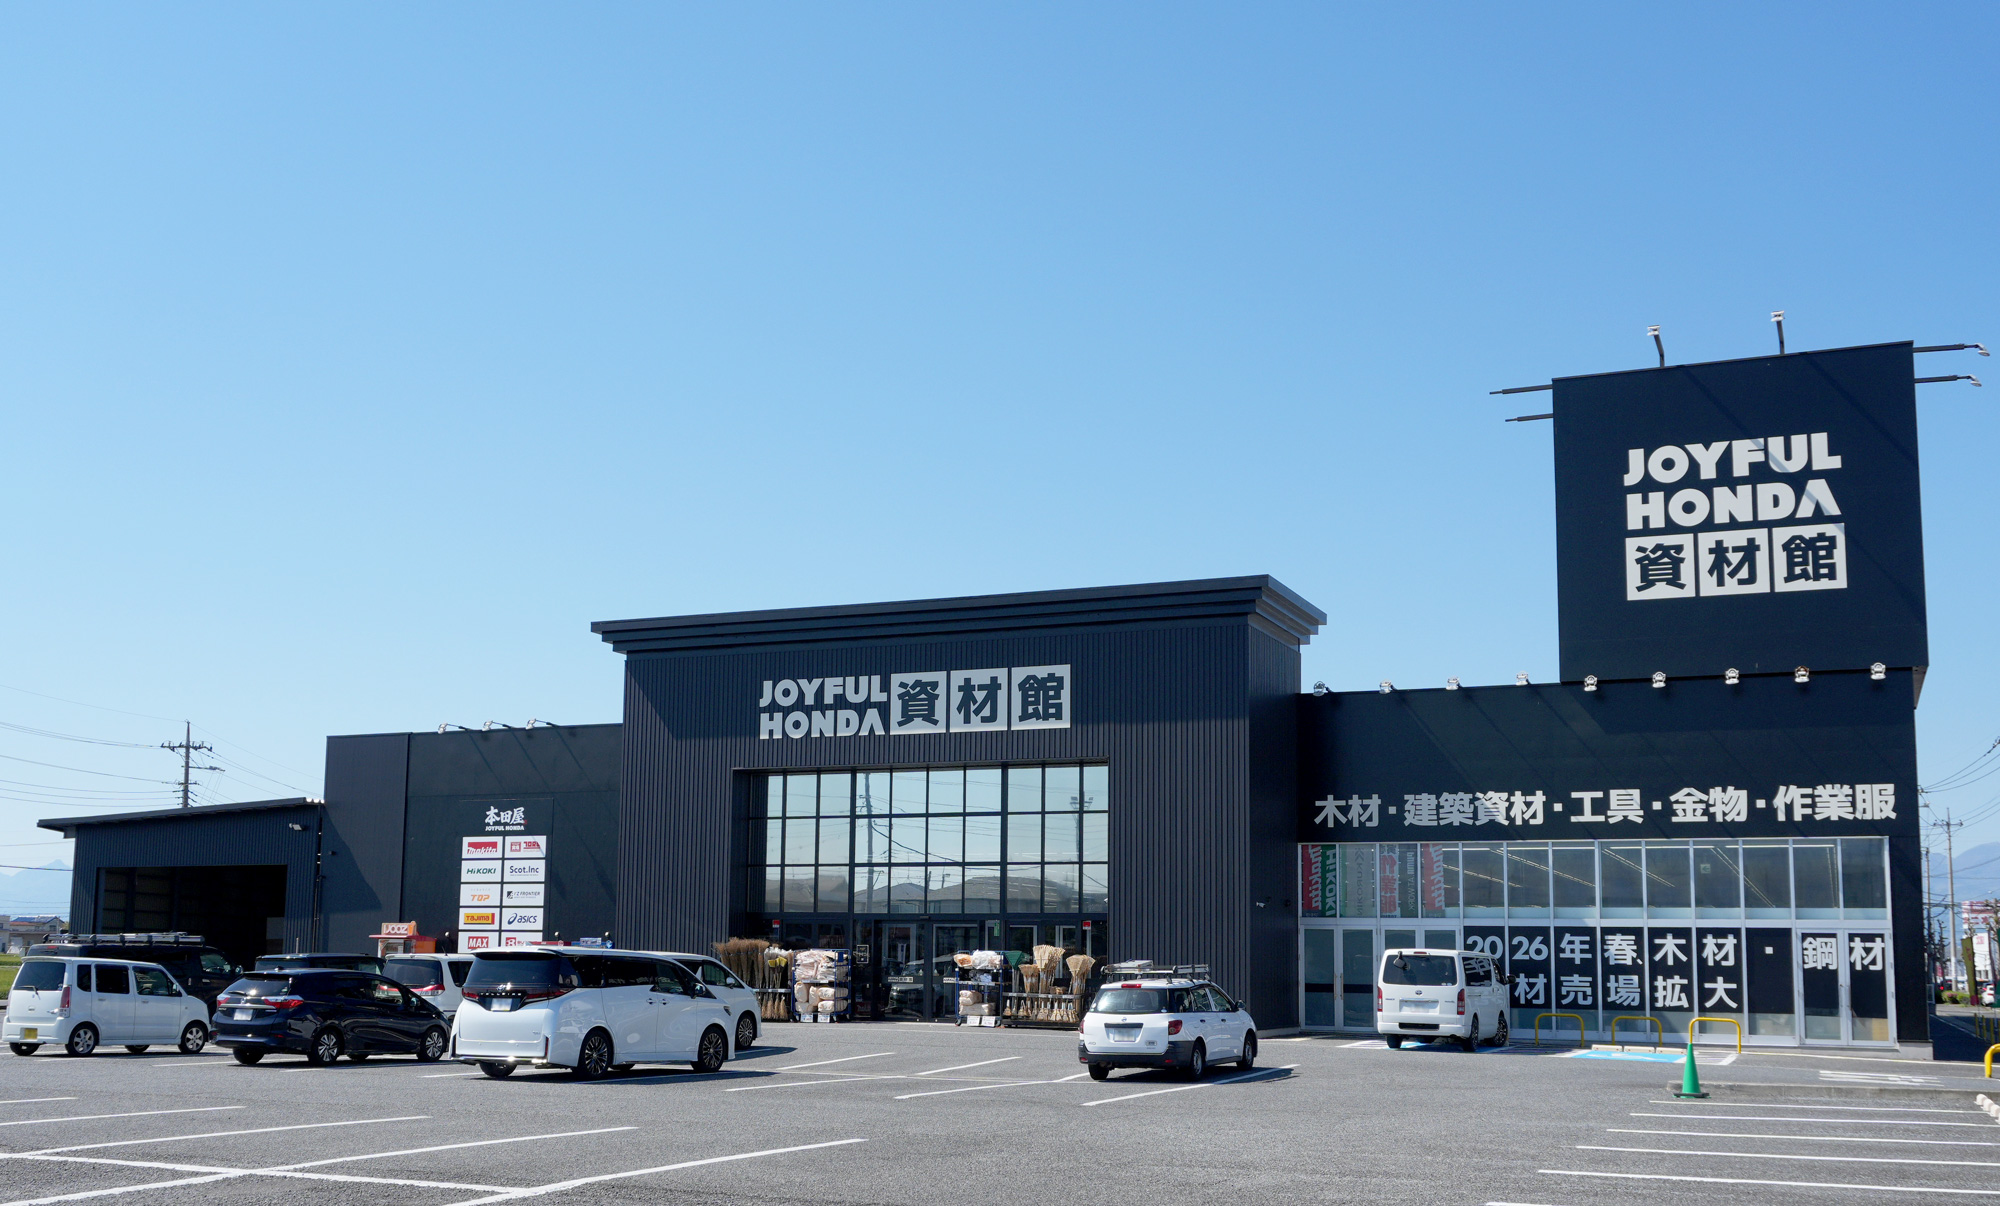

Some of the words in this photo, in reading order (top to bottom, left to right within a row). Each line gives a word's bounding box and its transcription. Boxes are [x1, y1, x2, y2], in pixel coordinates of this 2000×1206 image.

[1624, 432, 1842, 486] JOYFUL
[1626, 479, 1842, 530] HONDA
[1633, 530, 1840, 594] 資材館
[760, 675, 887, 707] JOYFUL
[894, 670, 1066, 729] 資材館
[760, 708, 885, 739] HONDA
[484, 806, 525, 825] 本田屋
[467, 845, 498, 854] makita
[466, 867, 497, 875] HiKOKI
[470, 894, 491, 902] TOP
[517, 915, 538, 924] asics
[468, 937, 488, 948] MAX
